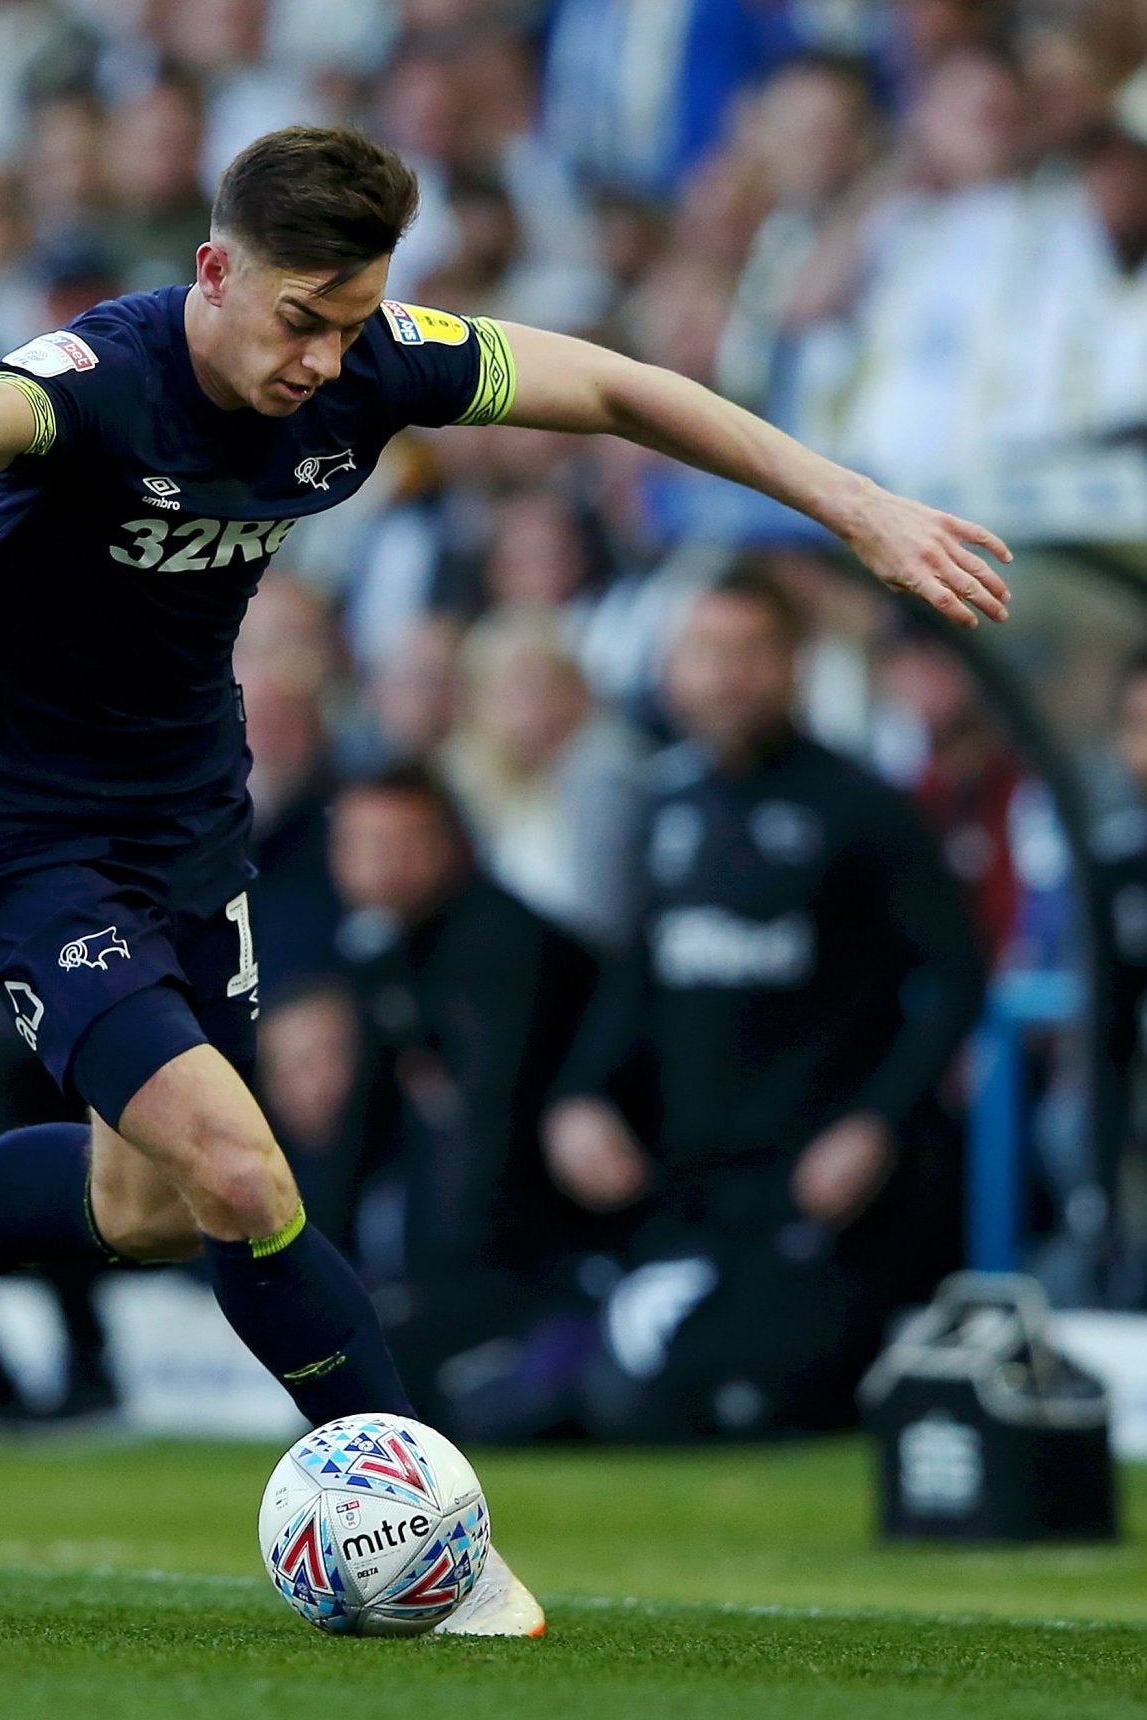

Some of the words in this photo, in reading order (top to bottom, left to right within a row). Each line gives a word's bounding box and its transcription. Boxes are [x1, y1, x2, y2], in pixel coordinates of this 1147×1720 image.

[63, 343, 89, 368] bet
[142, 496, 181, 511] umbro
[342, 1515, 430, 1560] mitre
[356, 1567, 379, 1579] DELTA
